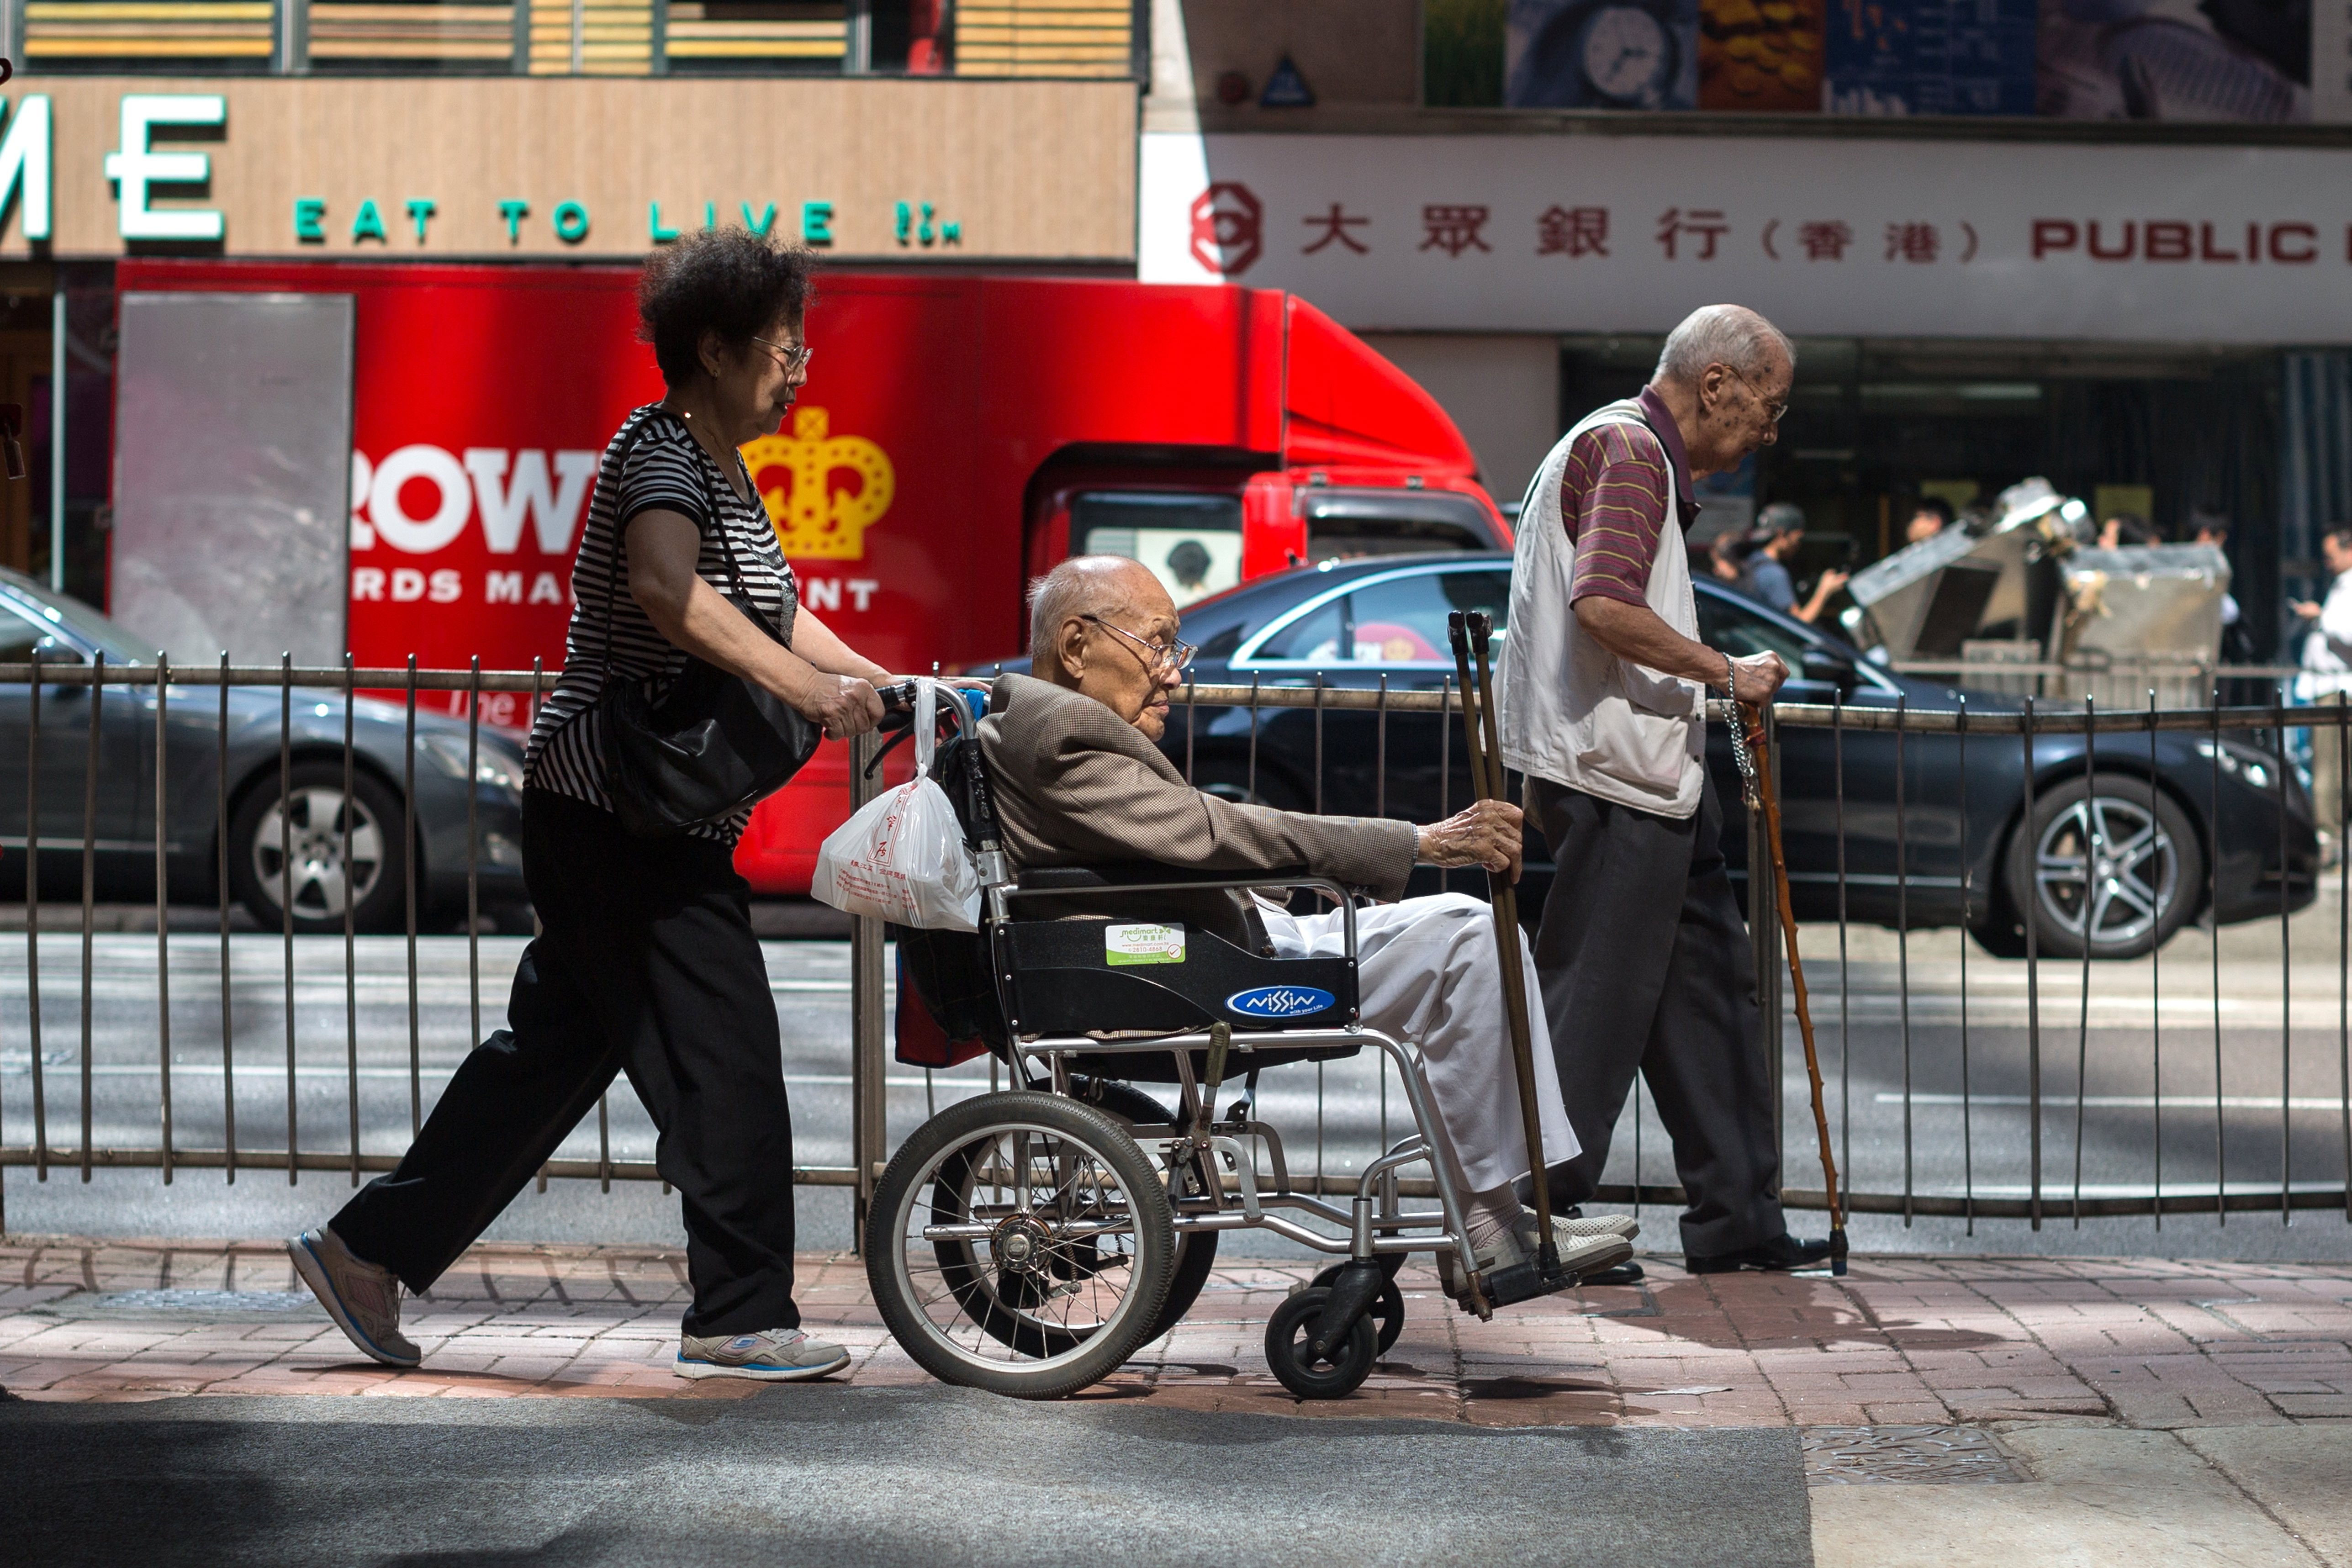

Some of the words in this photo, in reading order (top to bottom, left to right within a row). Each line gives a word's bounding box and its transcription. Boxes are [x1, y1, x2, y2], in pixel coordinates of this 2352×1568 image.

[294, 198, 436, 239] EAT
[498, 199, 589, 241] TO
[648, 200, 834, 241] LIVE
[2030, 219, 2320, 265] PUBLIC
[485, 569, 578, 606] MA
[796, 577, 880, 612] NT
[1120, 927, 1158, 938] medimart
